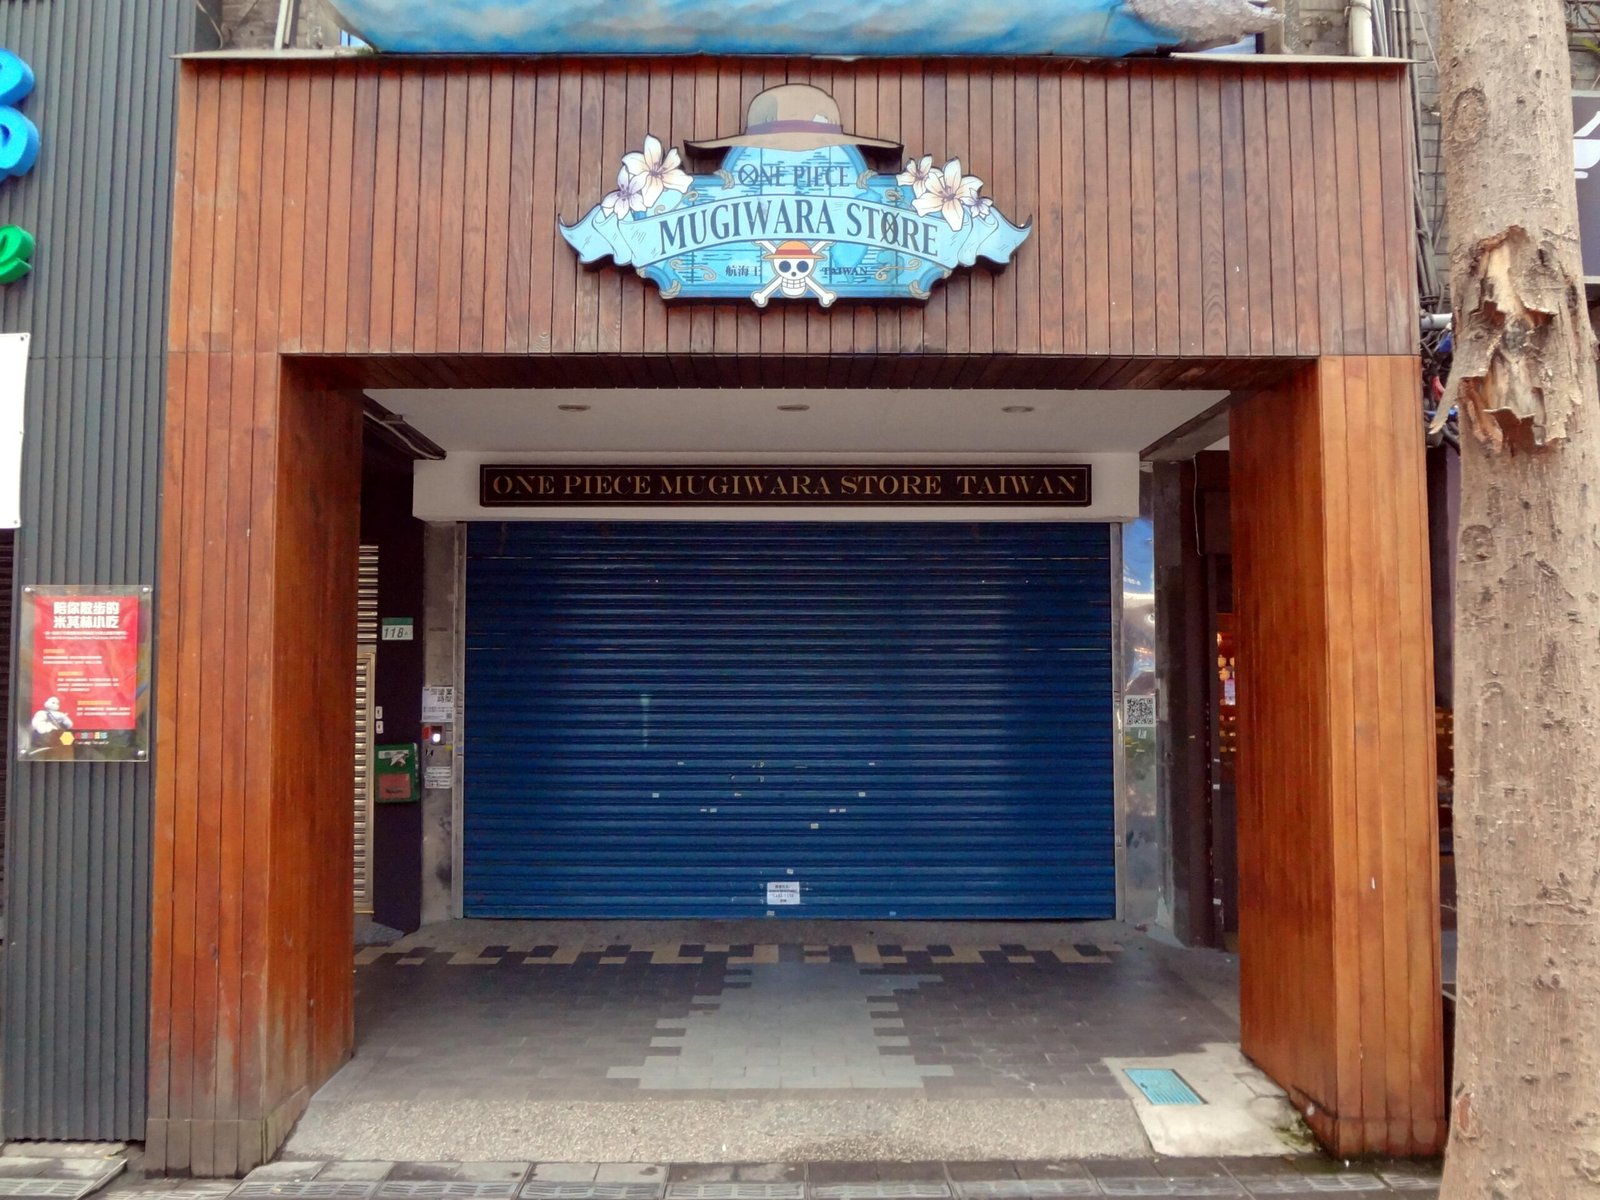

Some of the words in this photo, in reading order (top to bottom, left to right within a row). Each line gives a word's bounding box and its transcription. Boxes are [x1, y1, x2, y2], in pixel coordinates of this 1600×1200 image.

[738, 163, 786, 187] ONE
[793, 164, 850, 188] PIECE
[659, 198, 836, 256] MUGIWARA
[846, 202, 938, 257] STORE
[820, 266, 868, 276] TAIWAN
[493, 474, 555, 495] ONE
[563, 474, 650, 495] PIECE
[659, 474, 832, 495] MUGIWARA
[840, 474, 942, 495] STORE
[956, 474, 1078, 495] TAIWAN
